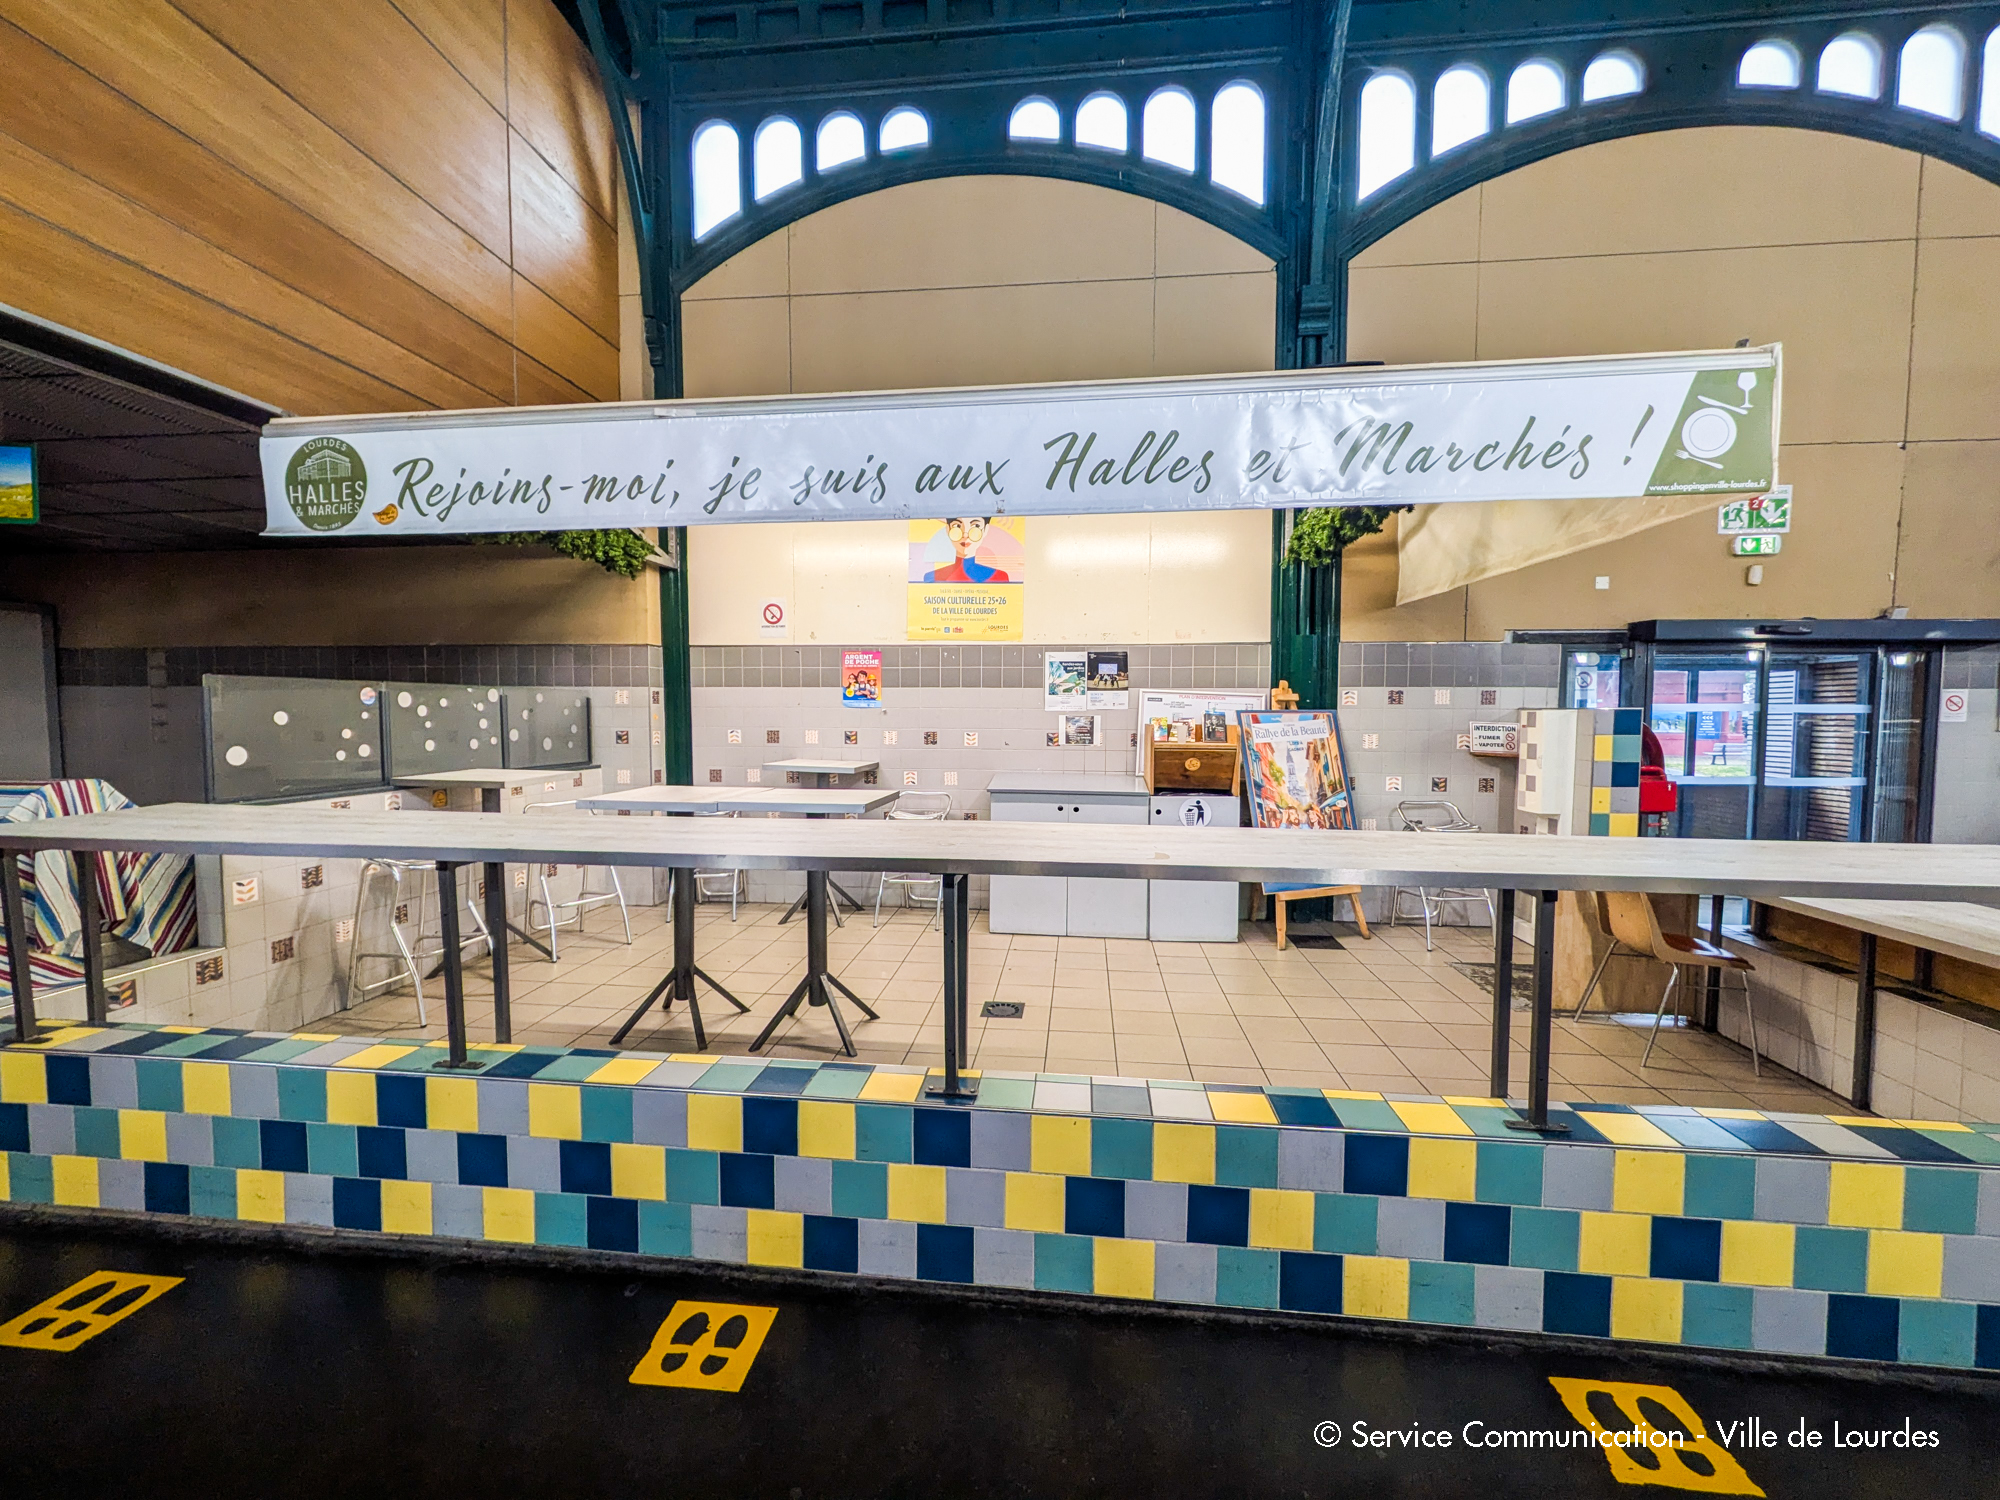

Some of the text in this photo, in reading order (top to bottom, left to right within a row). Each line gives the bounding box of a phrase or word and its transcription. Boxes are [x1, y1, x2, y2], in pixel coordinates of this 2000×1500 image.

[303, 438, 348, 453] LOURDES
[392, 404, 1655, 522] Rejoins-moi, je suis aux Halles et Marchés !
[289, 480, 365, 505] HALLES
[1649, 479, 1767, 492] www.shoppingenville-lourdes.fr
[295, 505, 304, 517] &
[308, 501, 360, 516] MARCHÉS
[1752, 500, 1759, 508] 2
[923, 596, 946, 605] SAISON
[947, 596, 986, 605] CULTURELLE
[973, 607, 998, 615] LOURDES
[1255, 724, 1327, 740] Rallye de la Beauté
